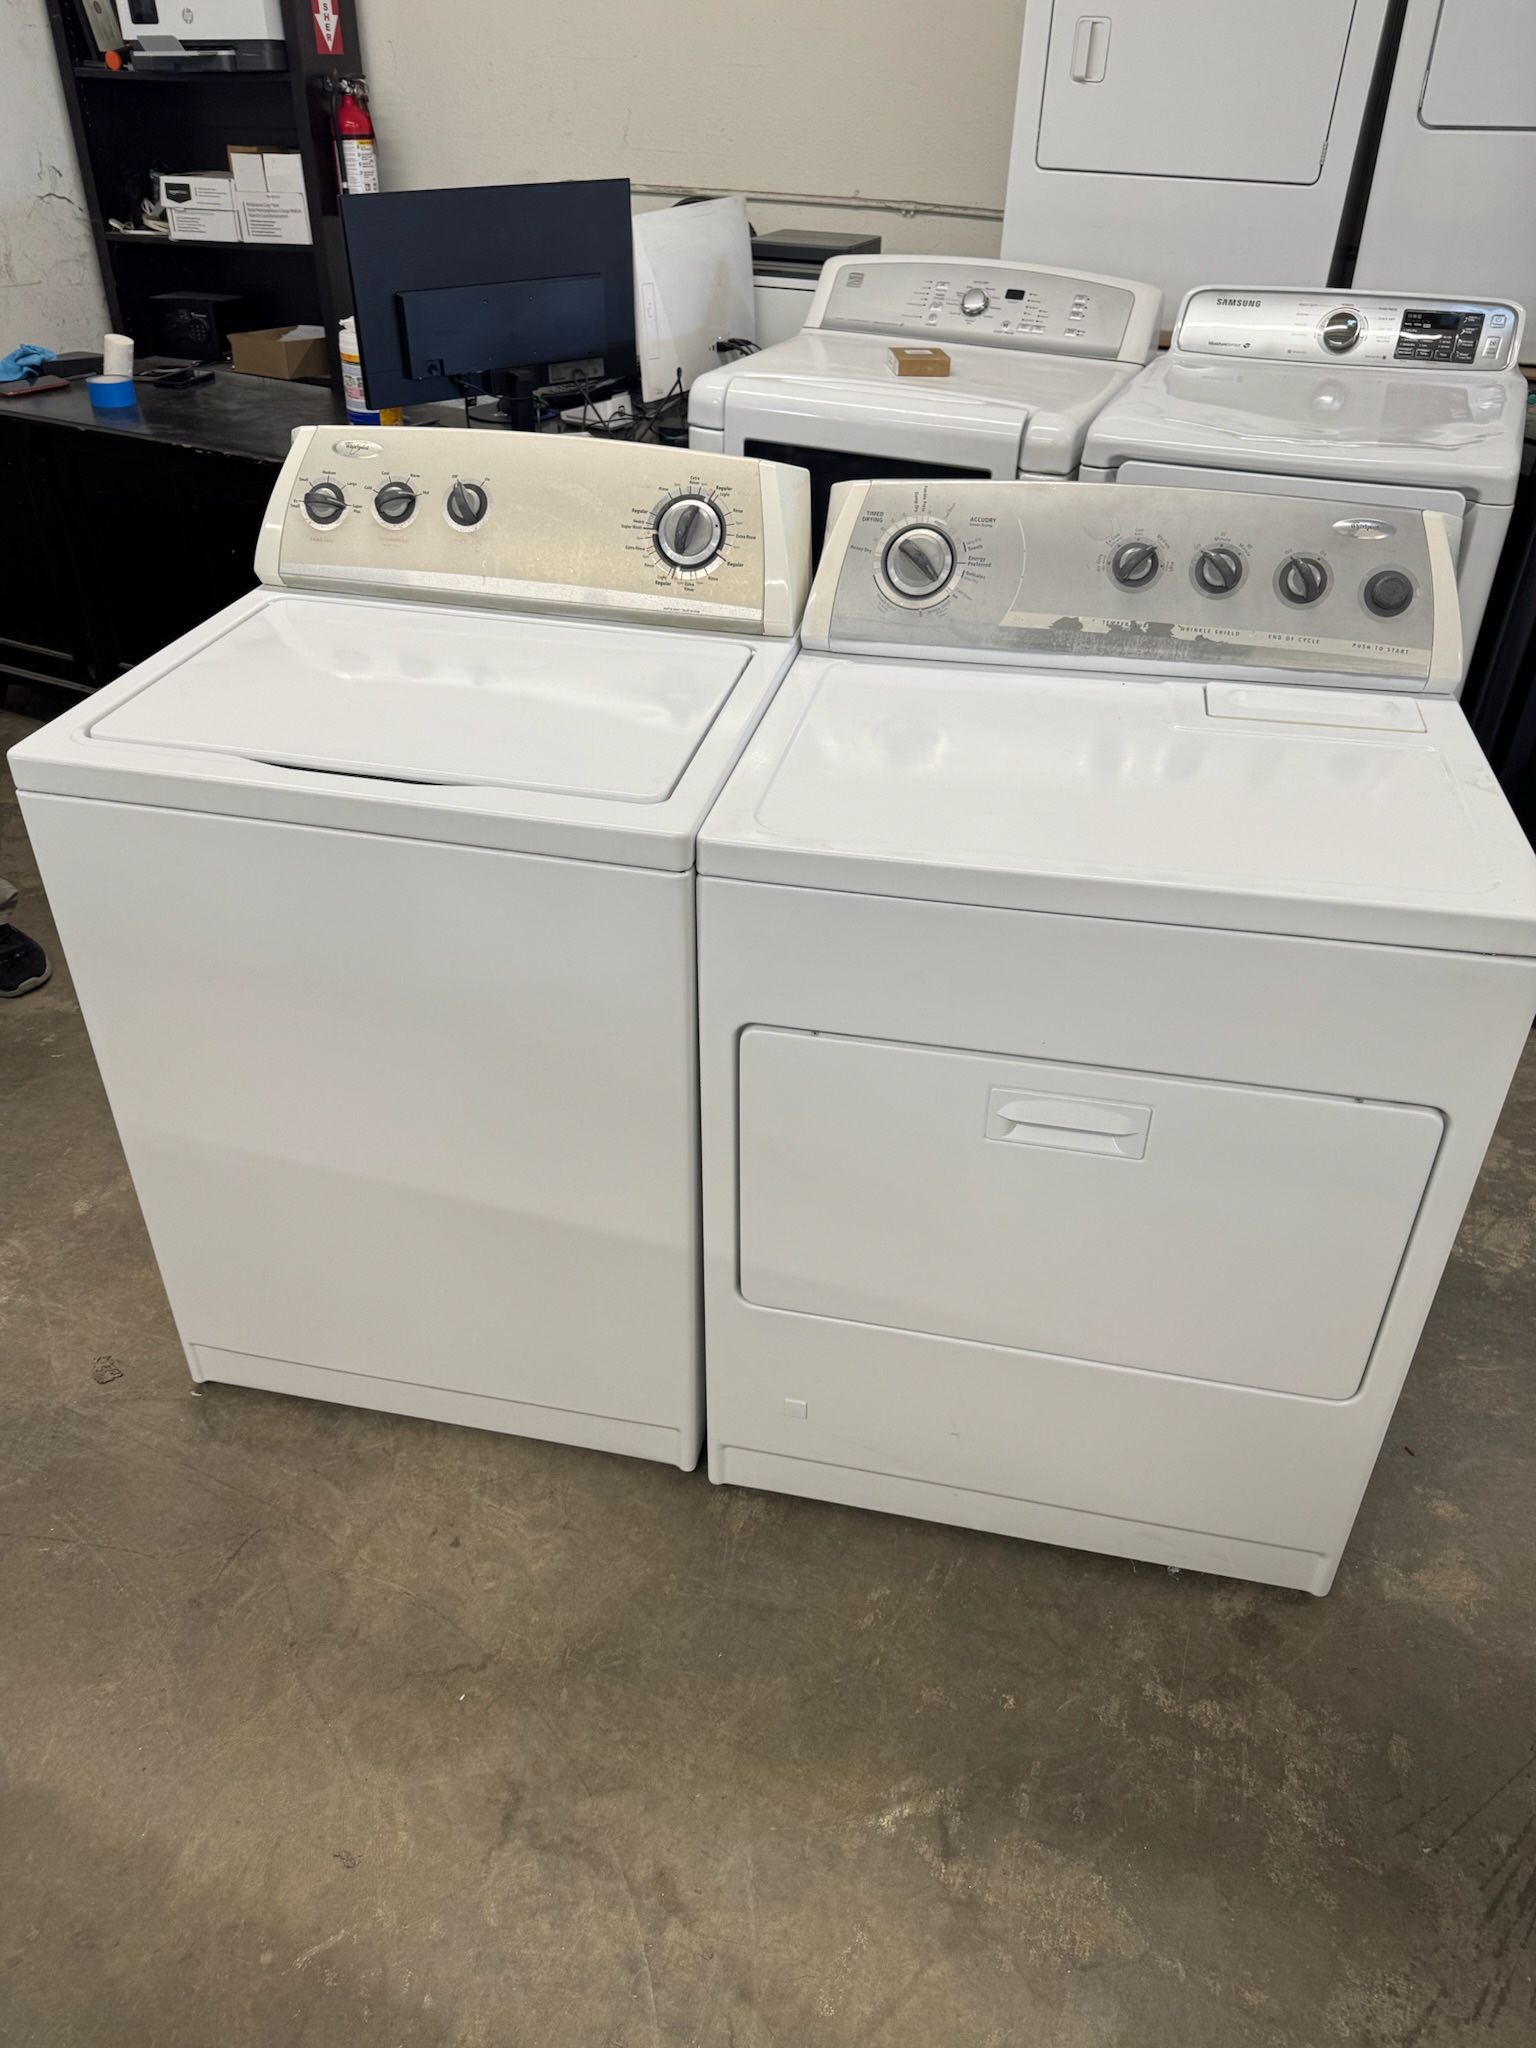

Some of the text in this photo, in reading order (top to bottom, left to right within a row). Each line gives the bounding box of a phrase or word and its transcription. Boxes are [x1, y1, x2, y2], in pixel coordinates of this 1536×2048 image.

[1216, 298, 1262, 308] SAMSUNG
[1180, 626, 1241, 637] WRINKLE SHIELD
[1298, 637, 1320, 645] CYCLE
[1352, 642, 1371, 650] PUSH
[1387, 646, 1409, 654] START
